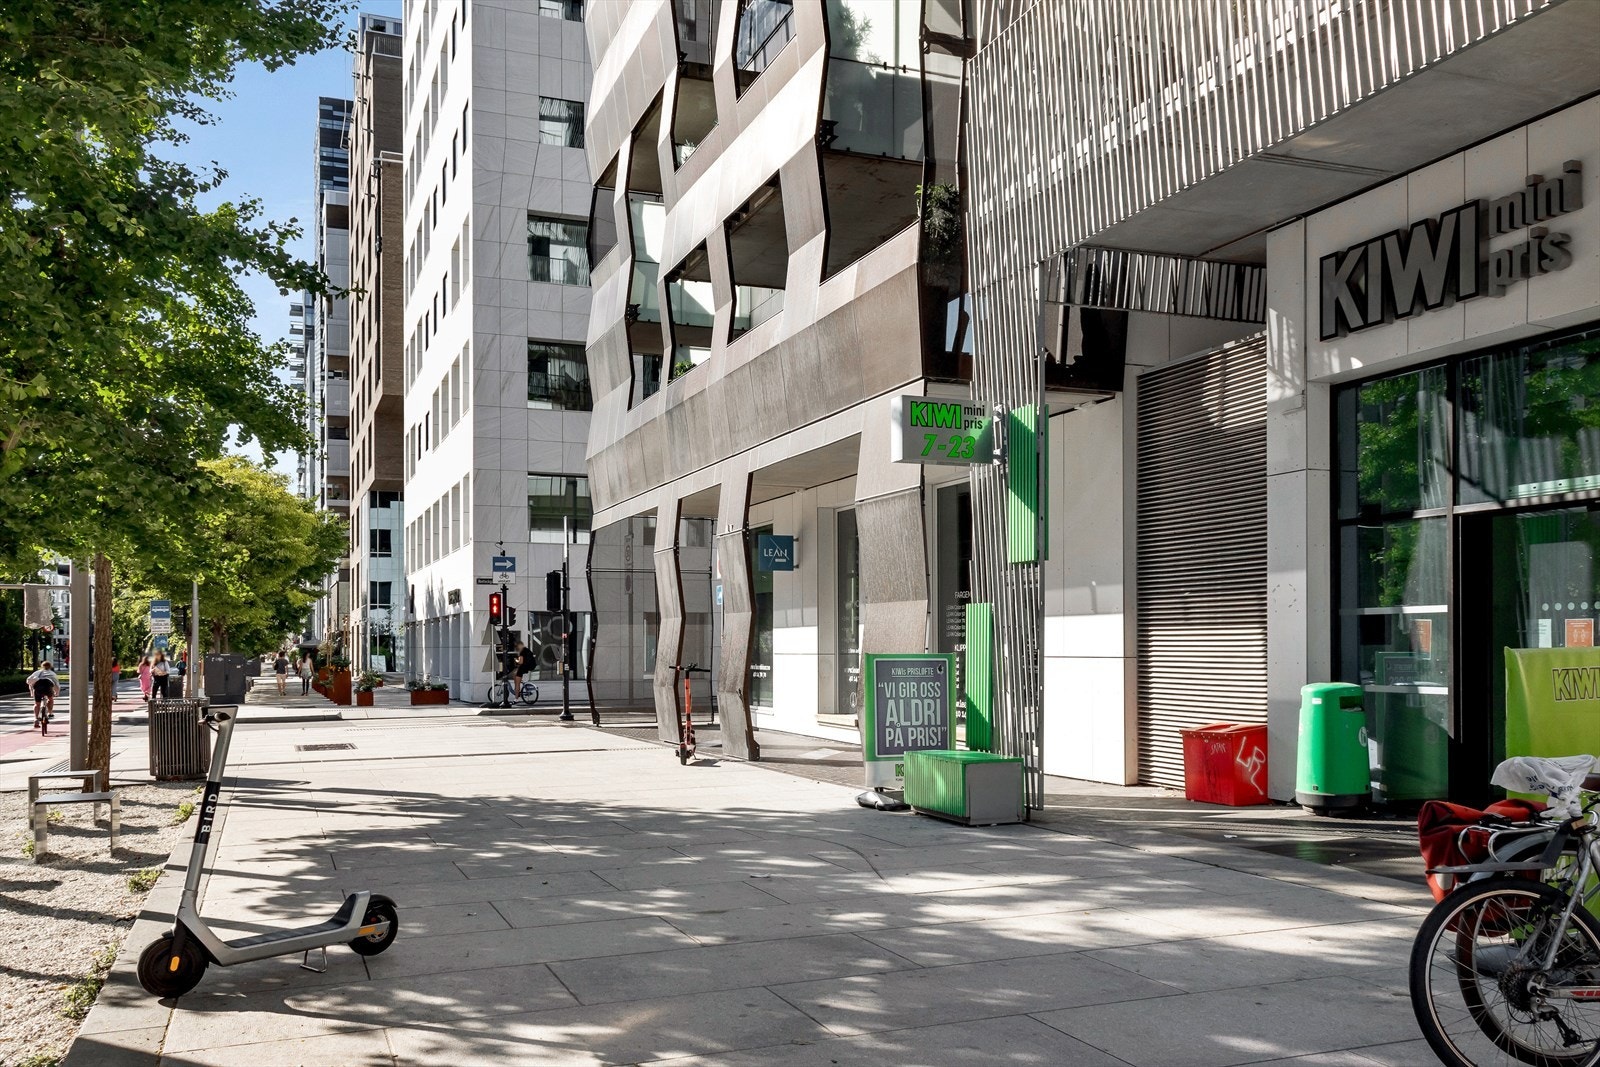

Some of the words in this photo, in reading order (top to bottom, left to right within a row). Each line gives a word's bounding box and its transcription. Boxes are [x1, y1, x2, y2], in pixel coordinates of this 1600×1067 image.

[1320, 199, 1487, 342] KIWI
[1488, 160, 1583, 238] mini
[1488, 226, 1573, 297] pris
[910, 401, 962, 430] KIWI
[963, 404, 985, 417] mini
[963, 418, 983, 430] pris
[763, 548, 788, 557] LEAN
[899, 682, 918, 698] GIR
[920, 682, 941, 698] OSS
[1552, 667, 1600, 701] KIWI
[885, 699, 941, 727] ALDRI
[885, 722, 905, 748] PÅ
[201, 794, 218, 834] BIRD
